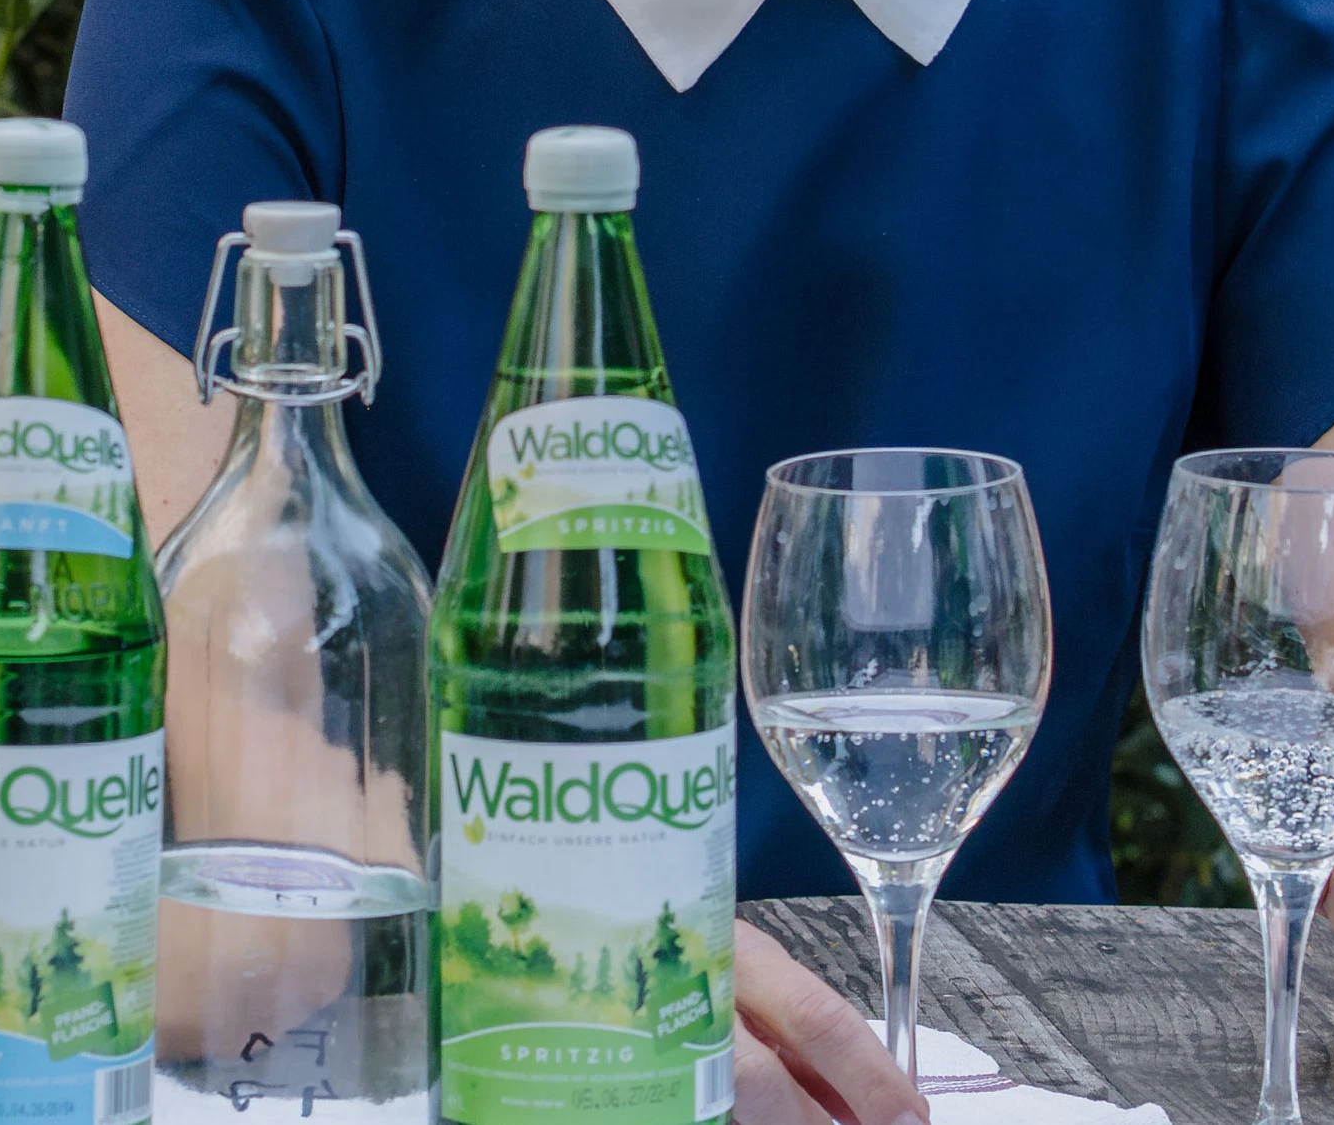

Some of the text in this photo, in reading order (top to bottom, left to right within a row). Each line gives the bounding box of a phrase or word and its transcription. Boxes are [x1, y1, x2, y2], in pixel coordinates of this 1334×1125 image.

[558, 517, 676, 536] SPRITZIG
[16, 837, 67, 850] NATUR
[486, 831, 667, 847] EINFACH UNSERE NATUR
[500, 1043, 635, 1065] SPRITZIG
